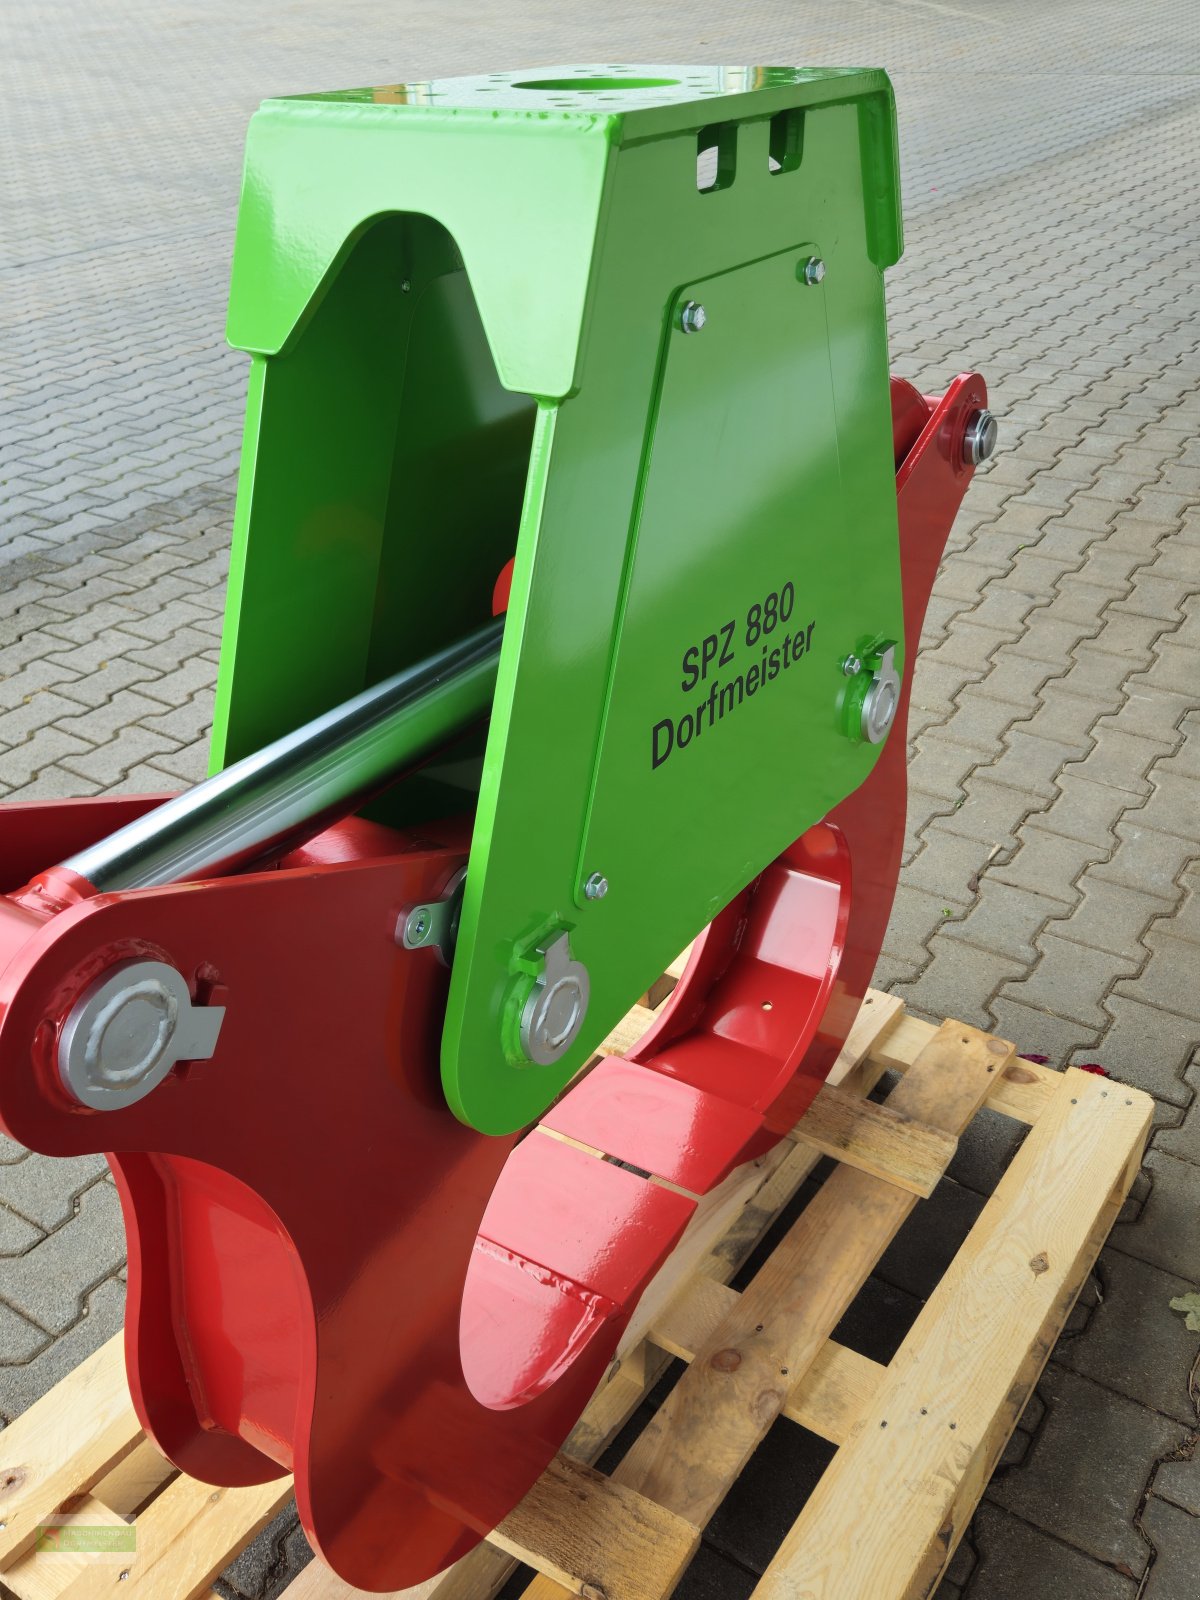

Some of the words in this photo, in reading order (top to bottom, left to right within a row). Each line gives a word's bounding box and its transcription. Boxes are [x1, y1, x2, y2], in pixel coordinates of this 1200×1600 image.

[652, 620, 816, 770] Dorfmeister
[681, 619, 736, 693] SPZ
[745, 581, 795, 647] 880
